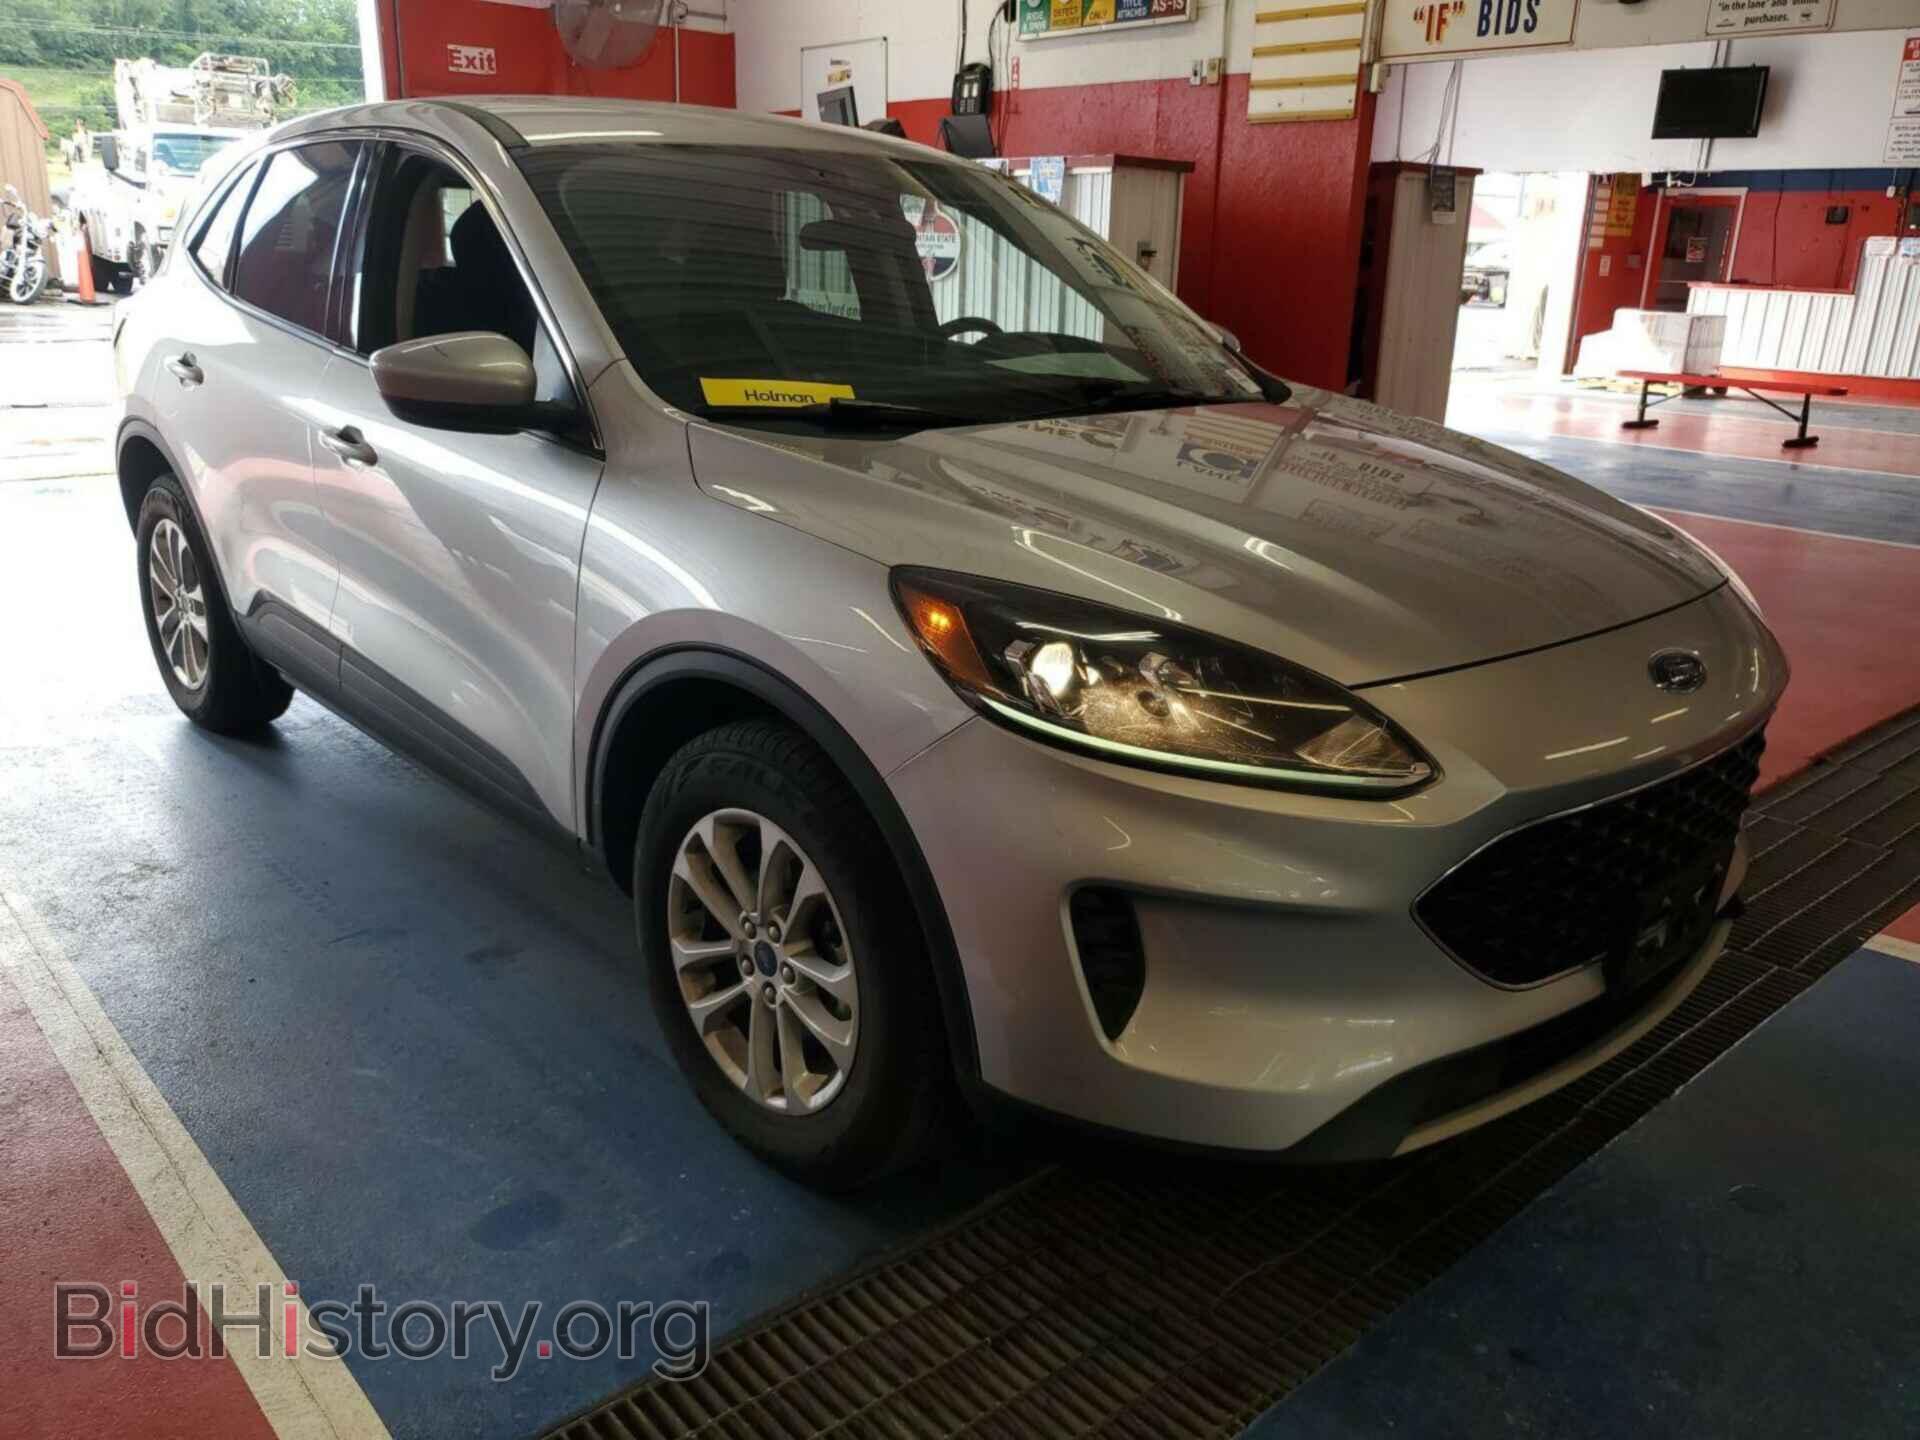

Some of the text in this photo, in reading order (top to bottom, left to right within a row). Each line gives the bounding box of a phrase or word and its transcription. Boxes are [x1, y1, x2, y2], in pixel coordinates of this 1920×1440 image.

[1151, 0, 1184, 13] AS-IS
[1476, 0, 1541, 37] BIDS
[449, 48, 495, 71] Exit
[744, 389, 816, 403] Holman
